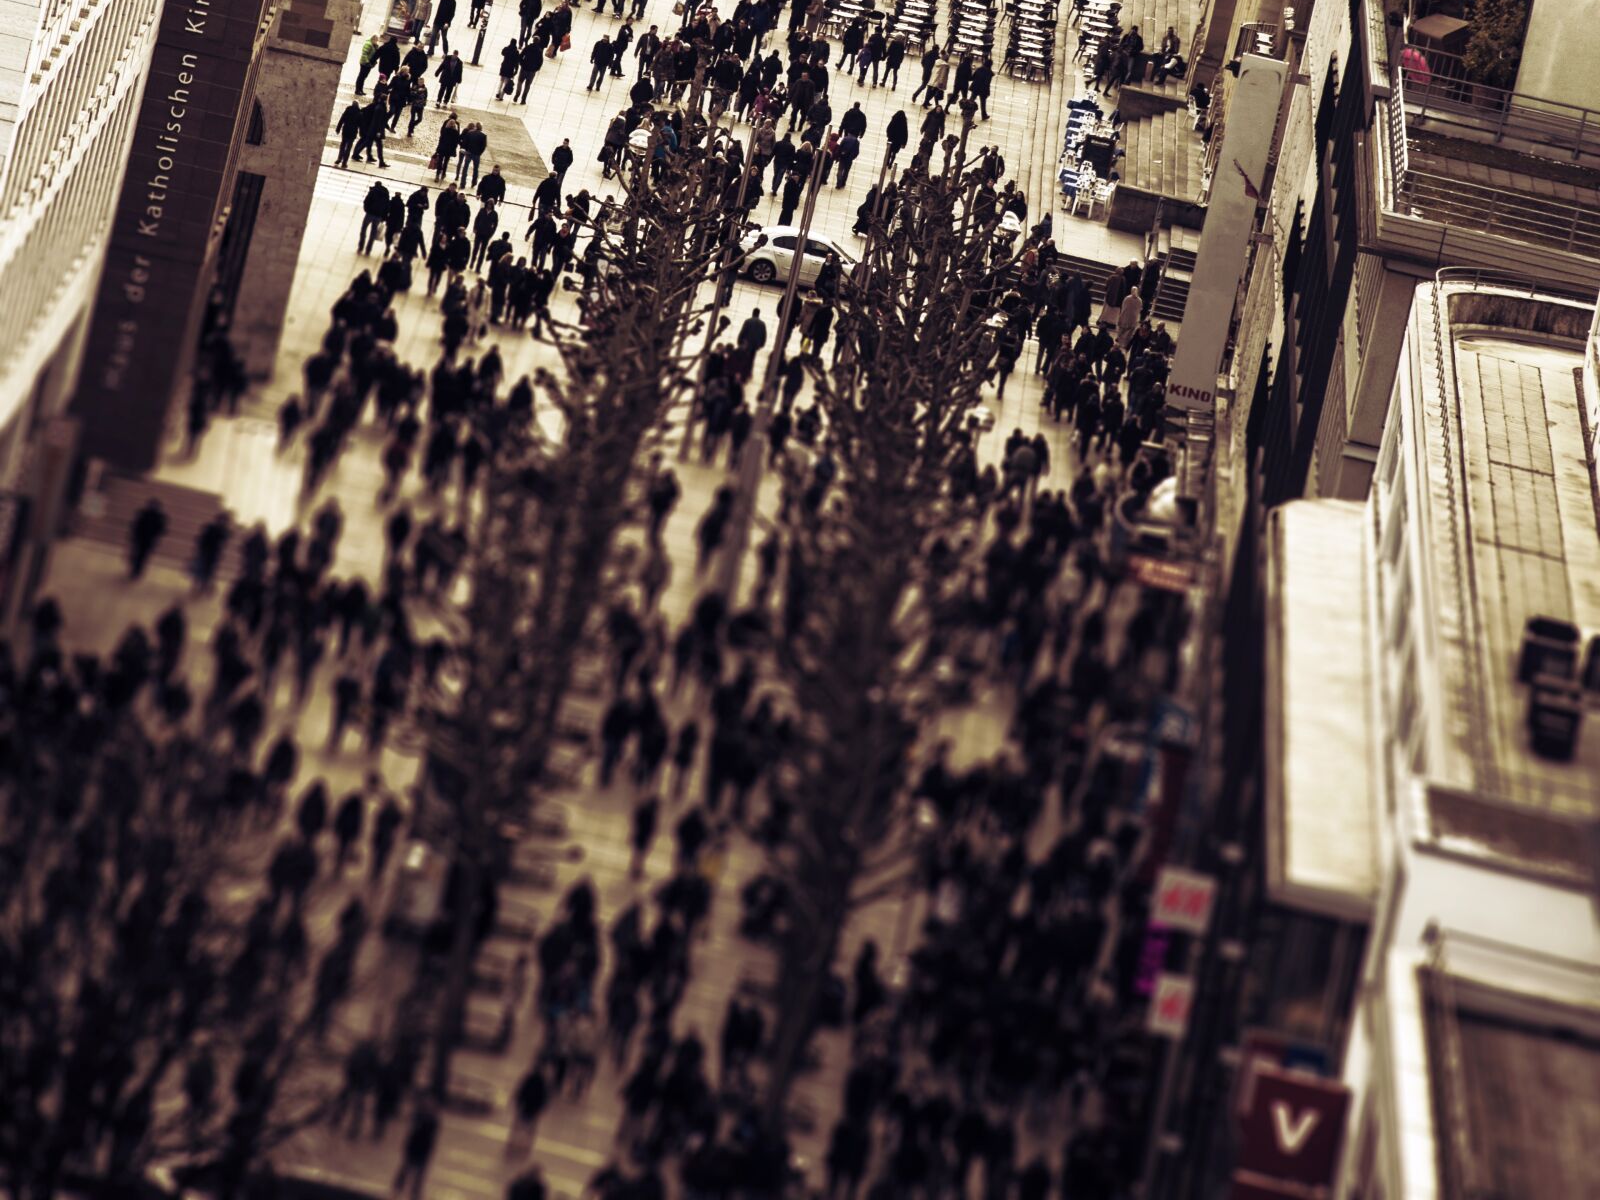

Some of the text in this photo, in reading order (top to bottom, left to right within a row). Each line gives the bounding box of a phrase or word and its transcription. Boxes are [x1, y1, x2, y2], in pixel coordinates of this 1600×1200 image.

[138, 54, 198, 236] Katholischen
[126, 256, 151, 302] der
[1169, 383, 1211, 403] KINO
[1273, 1102, 1318, 1152] V
